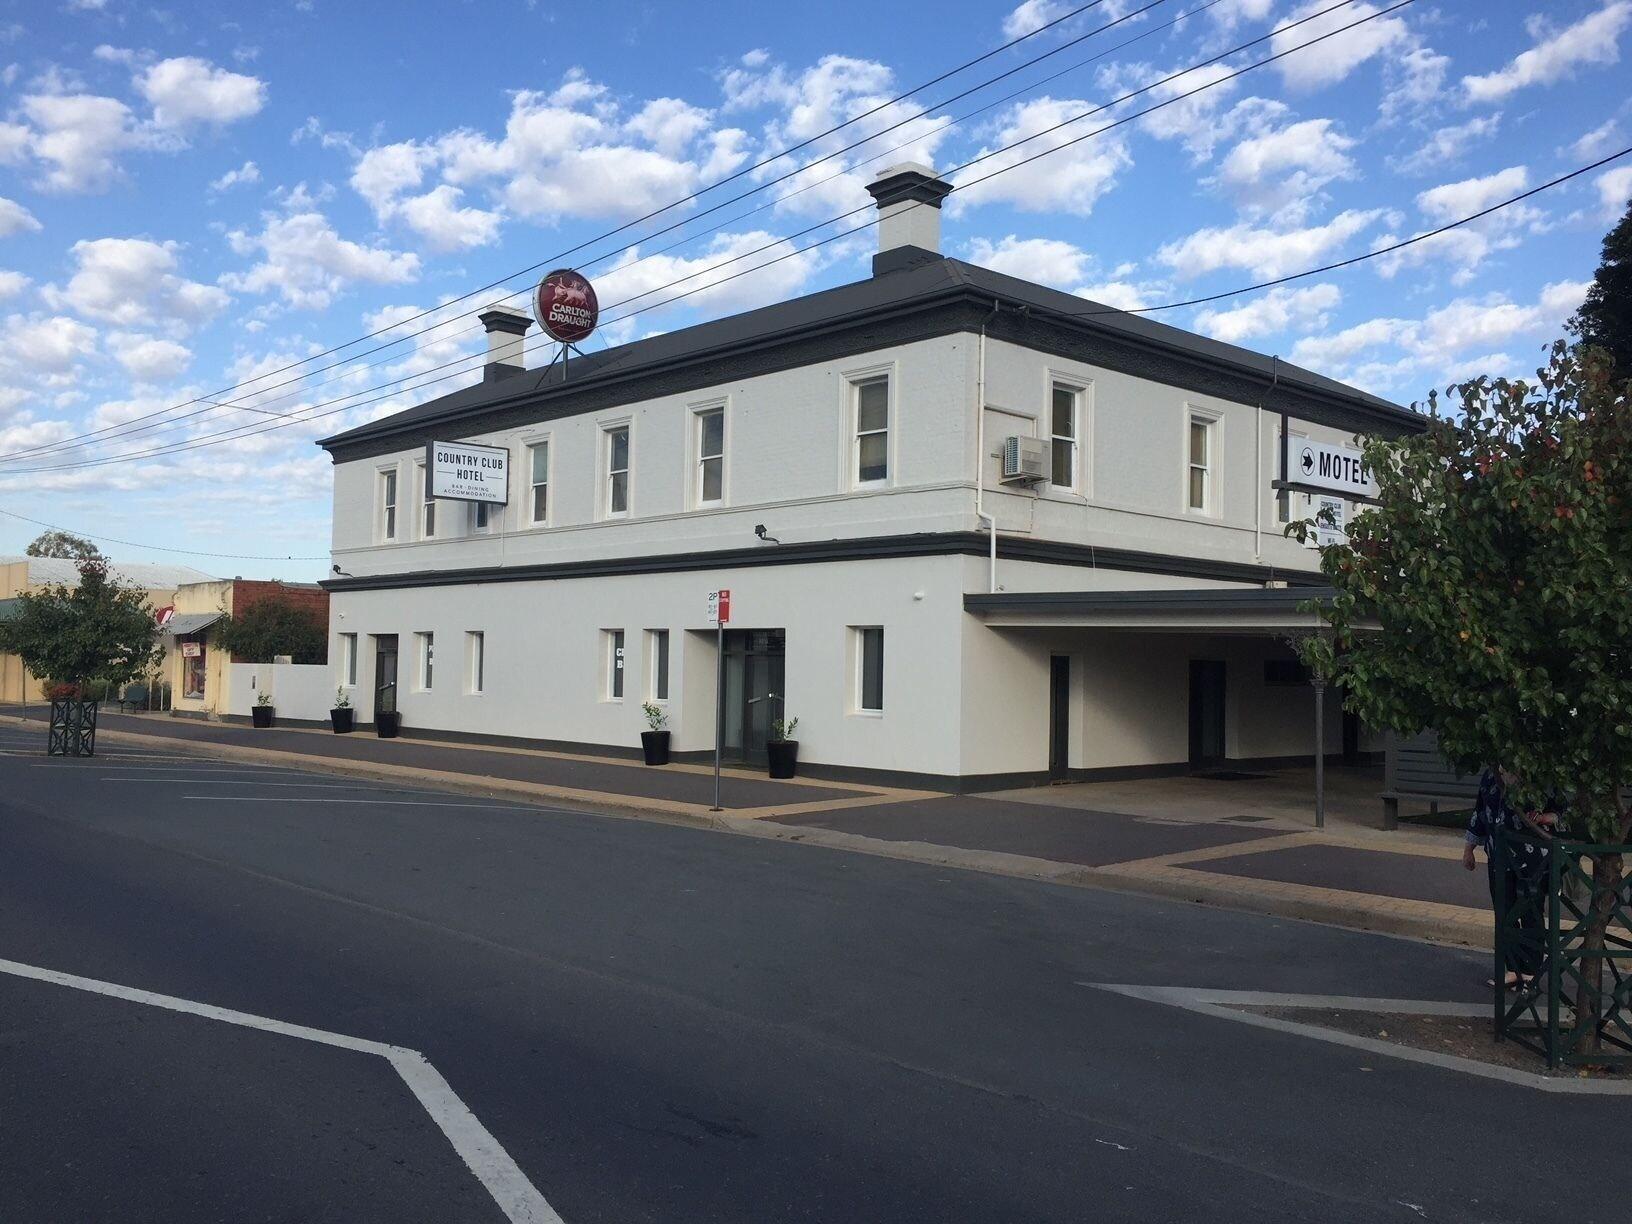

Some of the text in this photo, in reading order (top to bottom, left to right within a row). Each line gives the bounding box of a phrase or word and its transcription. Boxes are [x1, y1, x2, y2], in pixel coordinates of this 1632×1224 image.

[552, 303, 591, 318] CARLTON
[549, 311, 592, 328] DRAUGHT
[437, 452, 503, 470] COUNTRY CLUB
[1319, 451, 1368, 485] MOTEL
[457, 468, 484, 482] HOTEL
[443, 489, 496, 498] ACCOMMODATION
[708, 592, 718, 601] 2P
